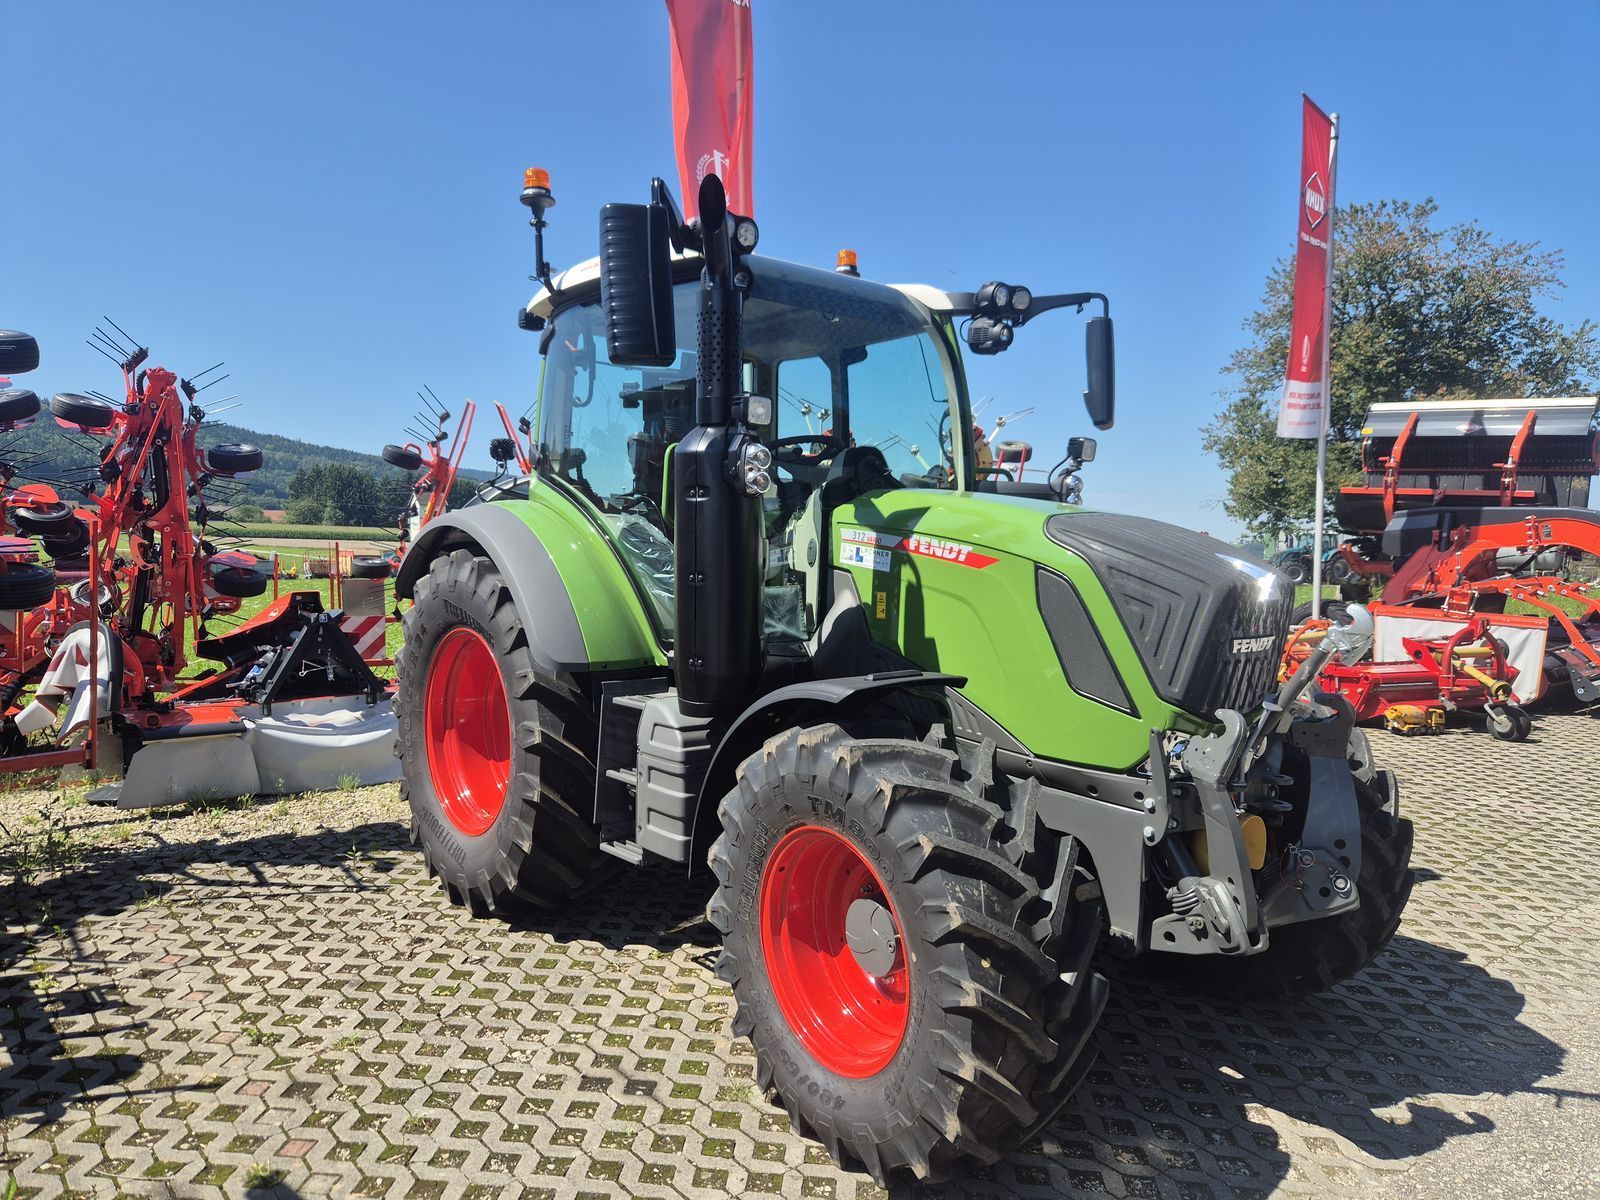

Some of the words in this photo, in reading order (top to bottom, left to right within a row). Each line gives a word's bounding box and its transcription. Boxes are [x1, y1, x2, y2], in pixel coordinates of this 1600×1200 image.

[852, 531, 866, 542] 312
[866, 536, 882, 545] VARIO
[909, 534, 973, 562] FENDT
[1232, 635, 1276, 654] FENDT
